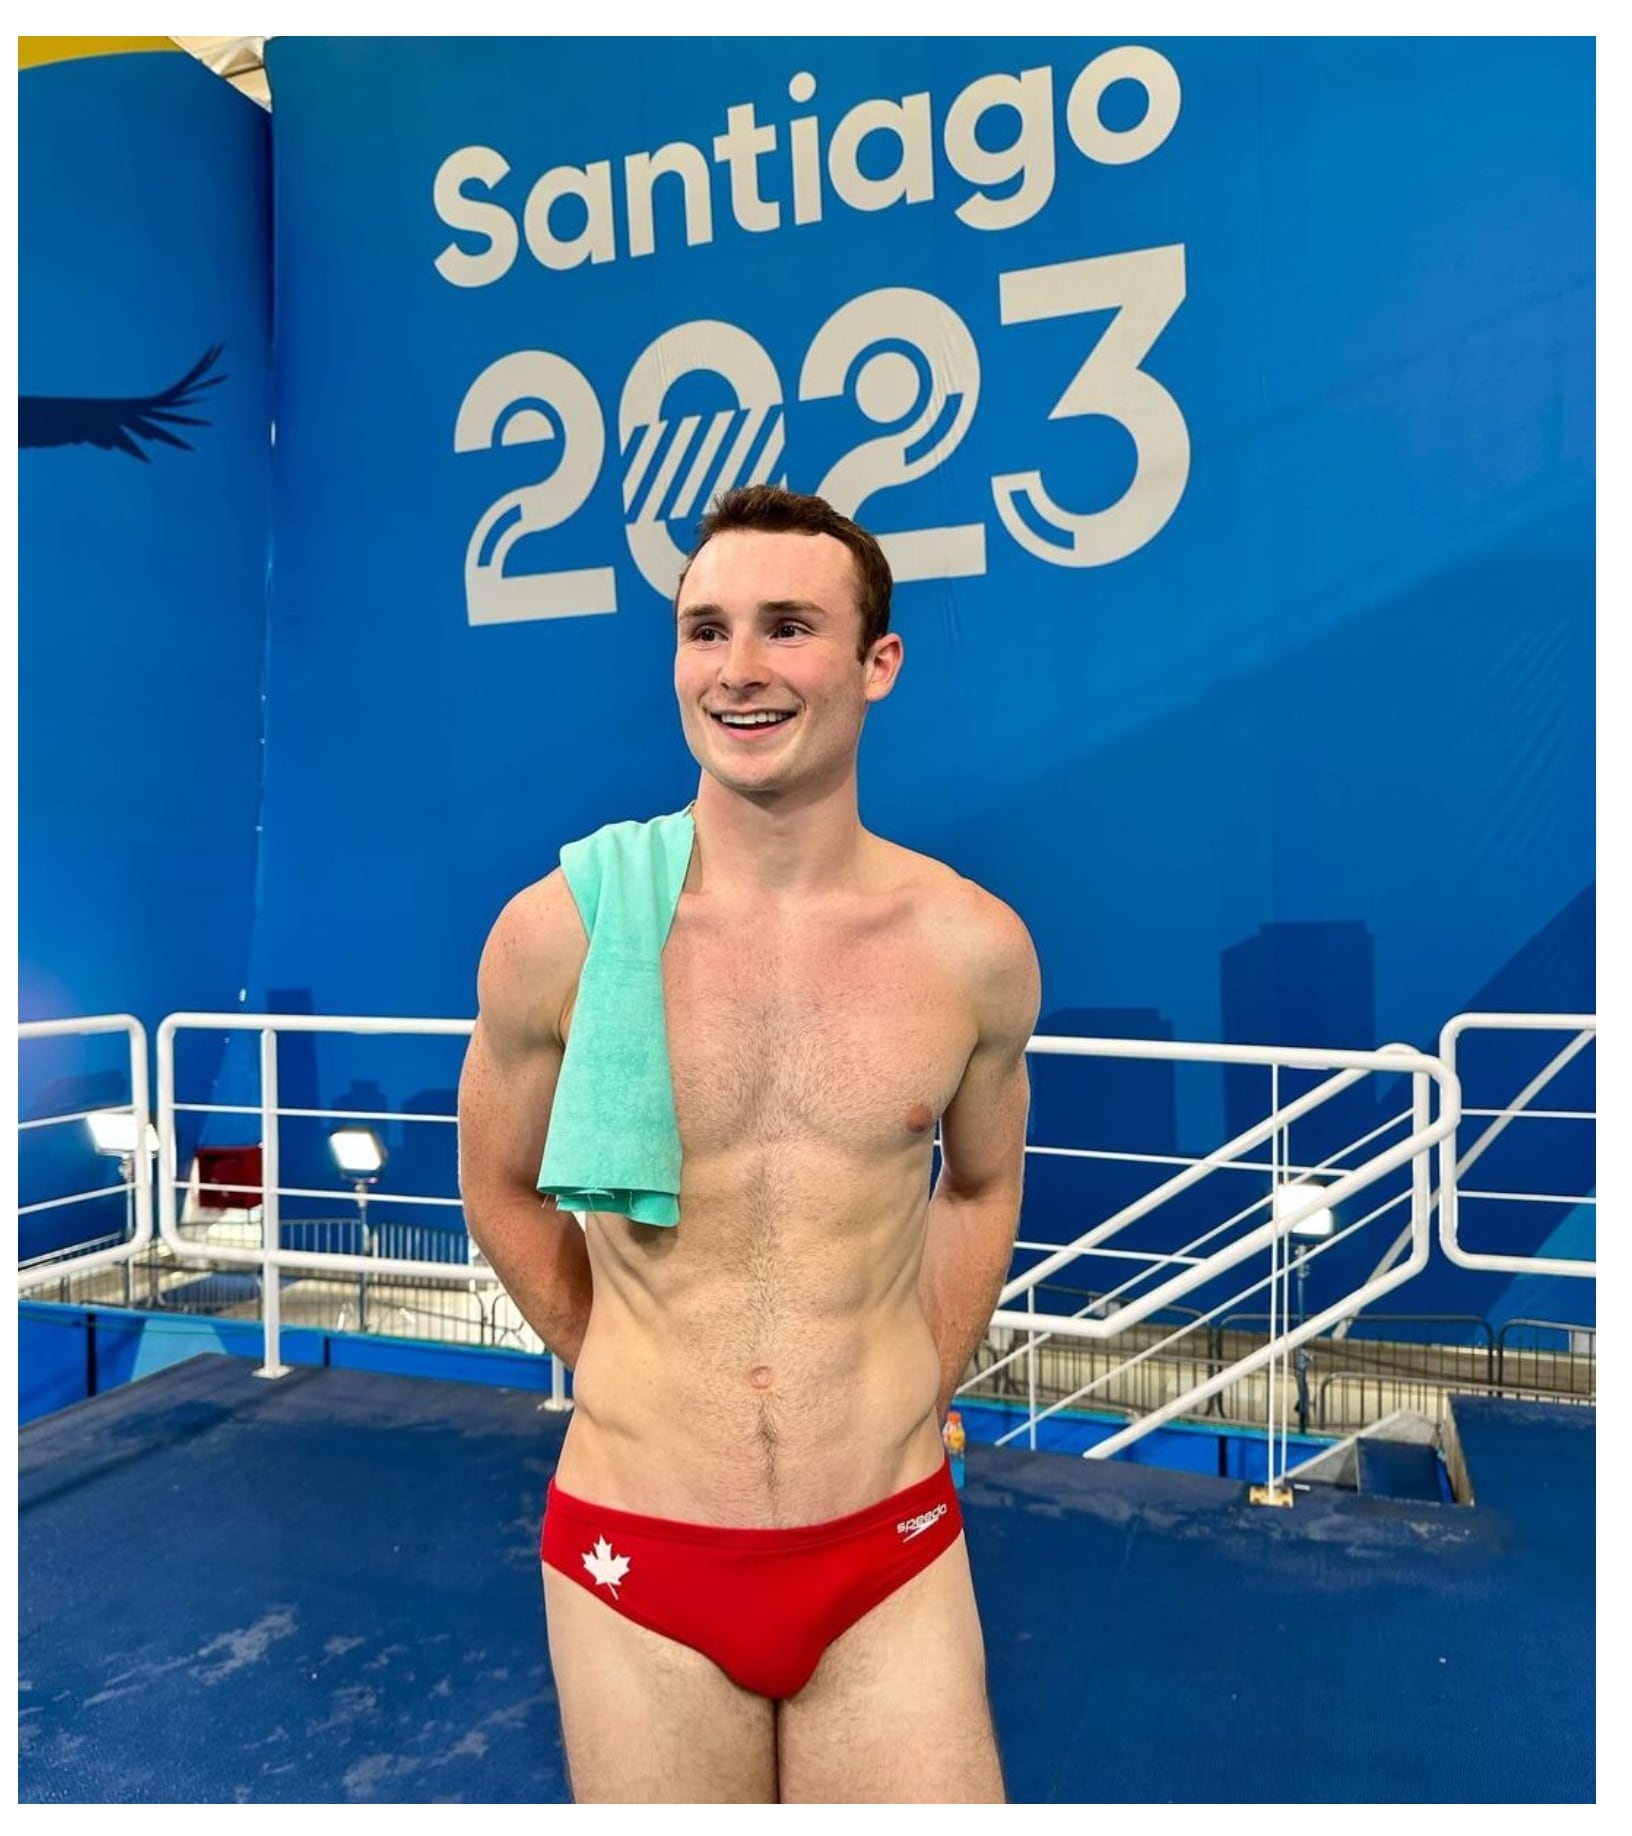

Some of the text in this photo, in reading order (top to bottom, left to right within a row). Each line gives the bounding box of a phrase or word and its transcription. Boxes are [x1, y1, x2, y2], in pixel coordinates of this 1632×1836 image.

[433, 44, 1181, 288] Santiago
[454, 242, 1191, 627] 2023
[896, 1503, 948, 1534] speedo
